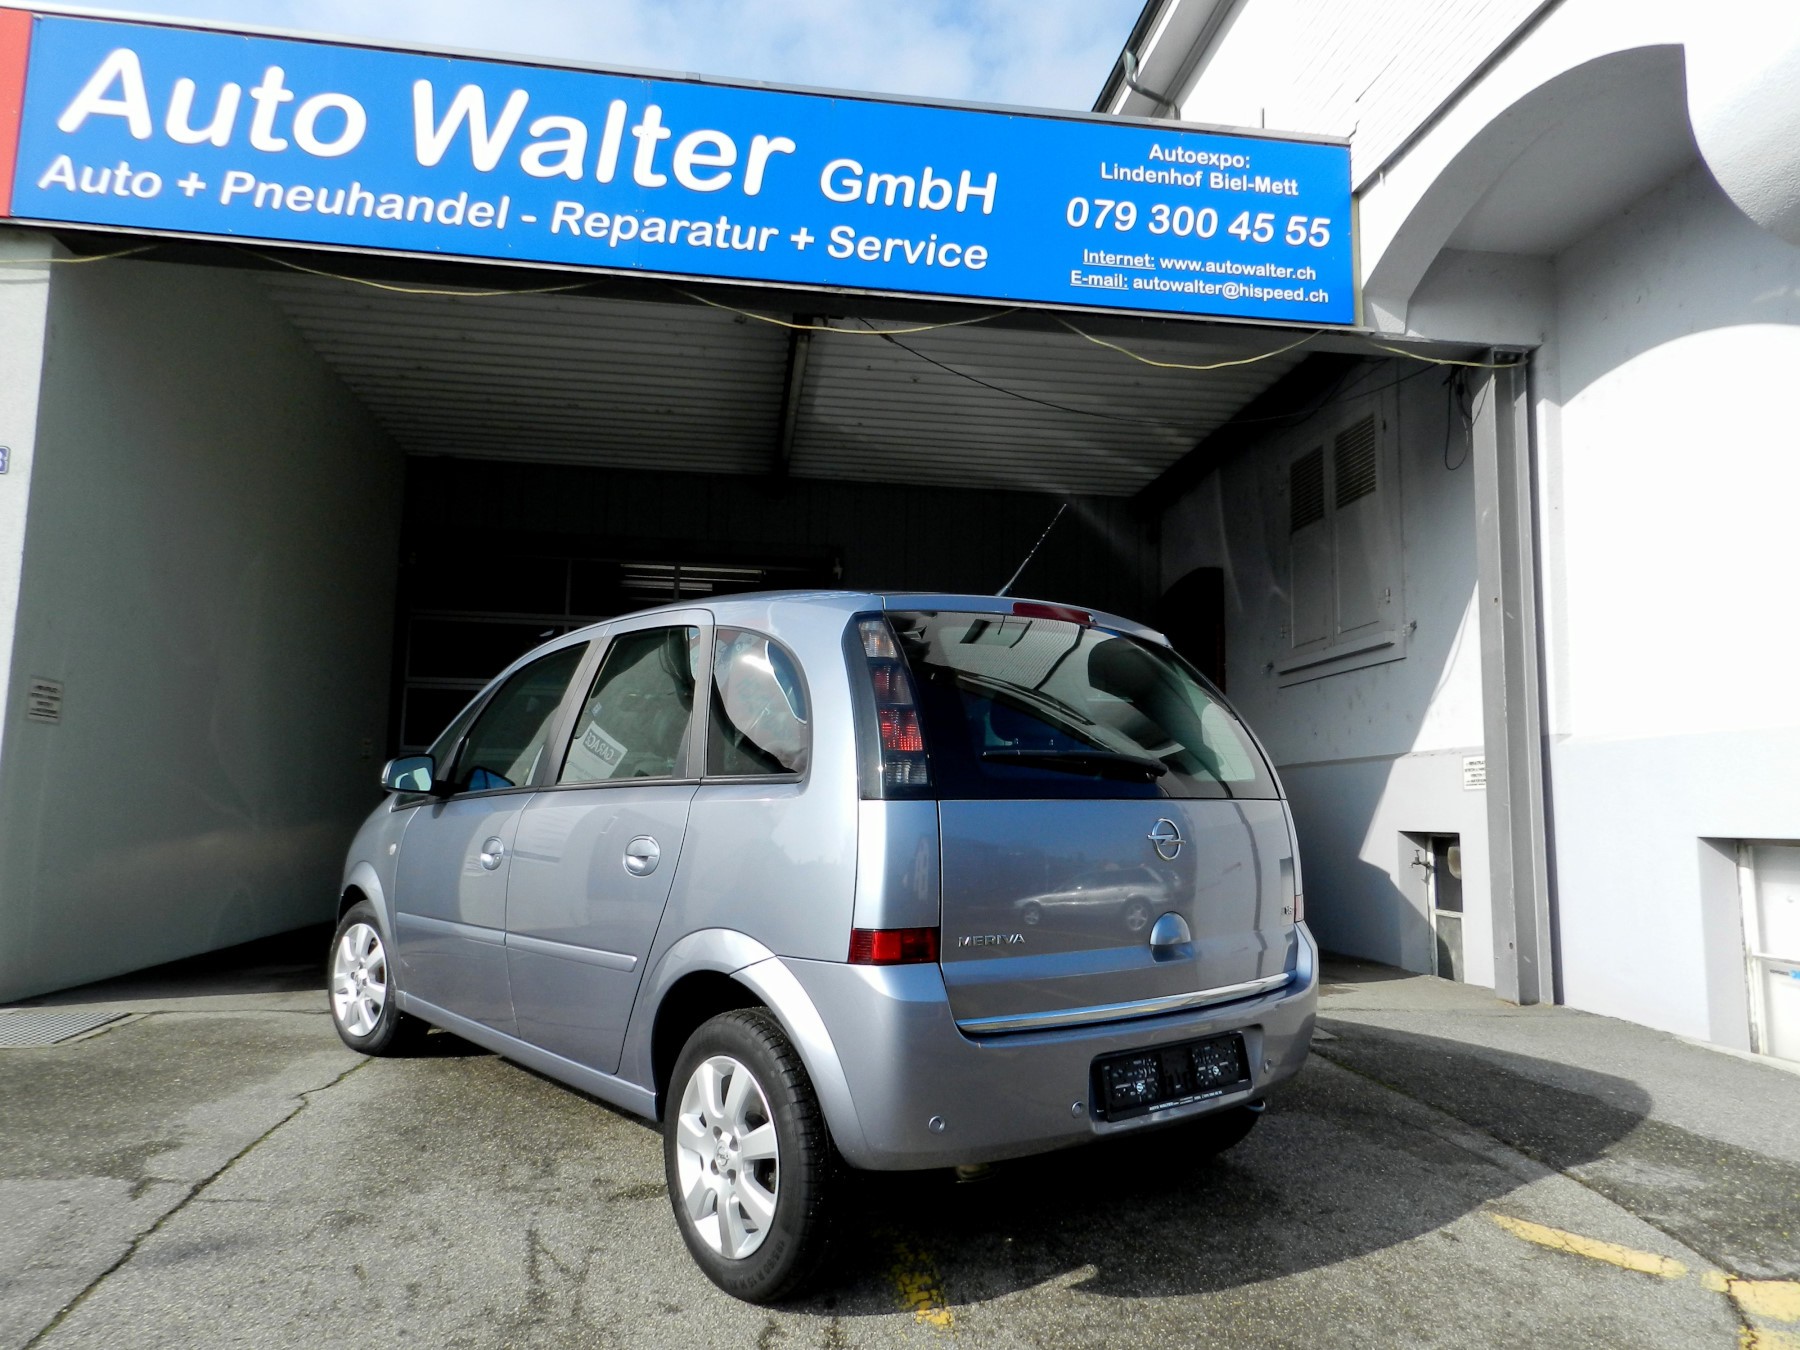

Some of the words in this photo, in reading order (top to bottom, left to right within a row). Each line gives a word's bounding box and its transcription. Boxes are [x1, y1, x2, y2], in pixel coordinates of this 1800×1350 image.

[57, 48, 367, 157] Auto
[414, 79, 796, 196] Walter
[820, 158, 998, 215] GmbH
[1149, 144, 1251, 170] Autoexpo:
[1101, 162, 1203, 187] Lindenhof
[1209, 172, 1299, 196] Biel-Mett
[37, 155, 162, 199] Auto
[220, 171, 510, 230] Pneuhandel
[550, 200, 779, 252] Reparatur
[827, 225, 989, 270] Service
[1066, 197, 1138, 232] 079
[1149, 204, 1218, 239] 300
[1228, 211, 1276, 243] 45
[1285, 215, 1332, 248] 55
[1083, 248, 1156, 270] Internet:
[1160, 257, 1317, 281] www.autowalter.ch
[1070, 270, 1129, 291] E-mail:
[1133, 277, 1329, 303] autowalter@hispeed.ch
[958, 933, 1026, 948] MERIVA
